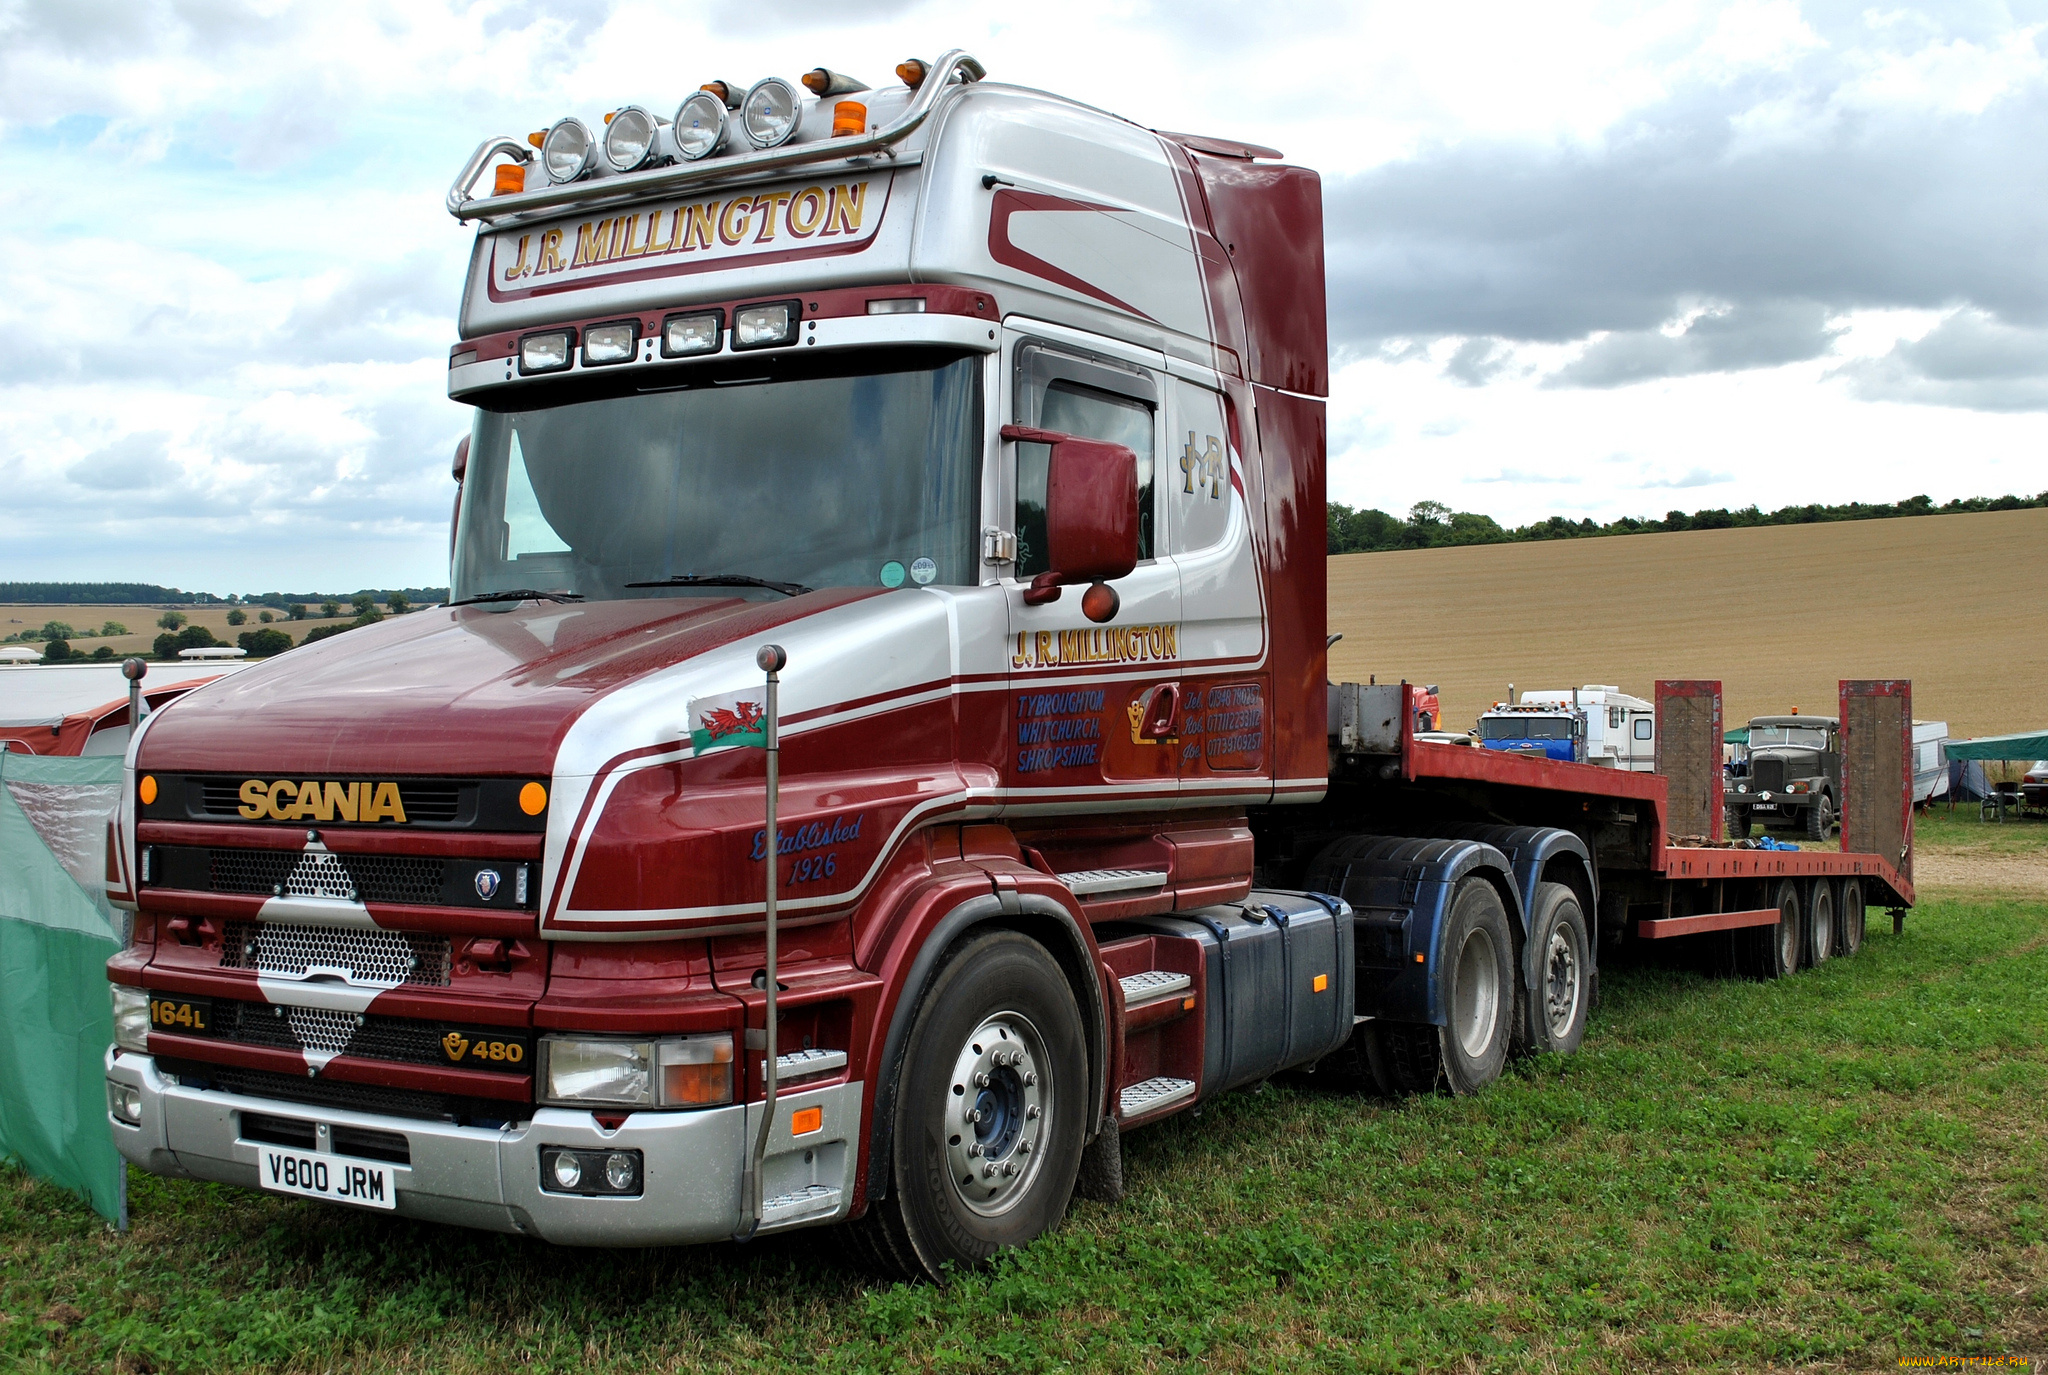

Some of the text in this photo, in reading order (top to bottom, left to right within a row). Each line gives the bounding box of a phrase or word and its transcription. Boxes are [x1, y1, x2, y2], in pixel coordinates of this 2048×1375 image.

[569, 181, 870, 271] MILLINGTON
[1057, 624, 1178, 667] MILLINGTON
[1208, 689, 1232, 709] 01948
[1017, 743, 1099, 773] SHROPSHIRE.
[238, 779, 408, 822] SCANIA
[750, 814, 864, 861] Etablished
[786, 852, 838, 888] 1926
[472, 1041, 523, 1062] 480
[269, 1153, 385, 1201] V800 JRM
